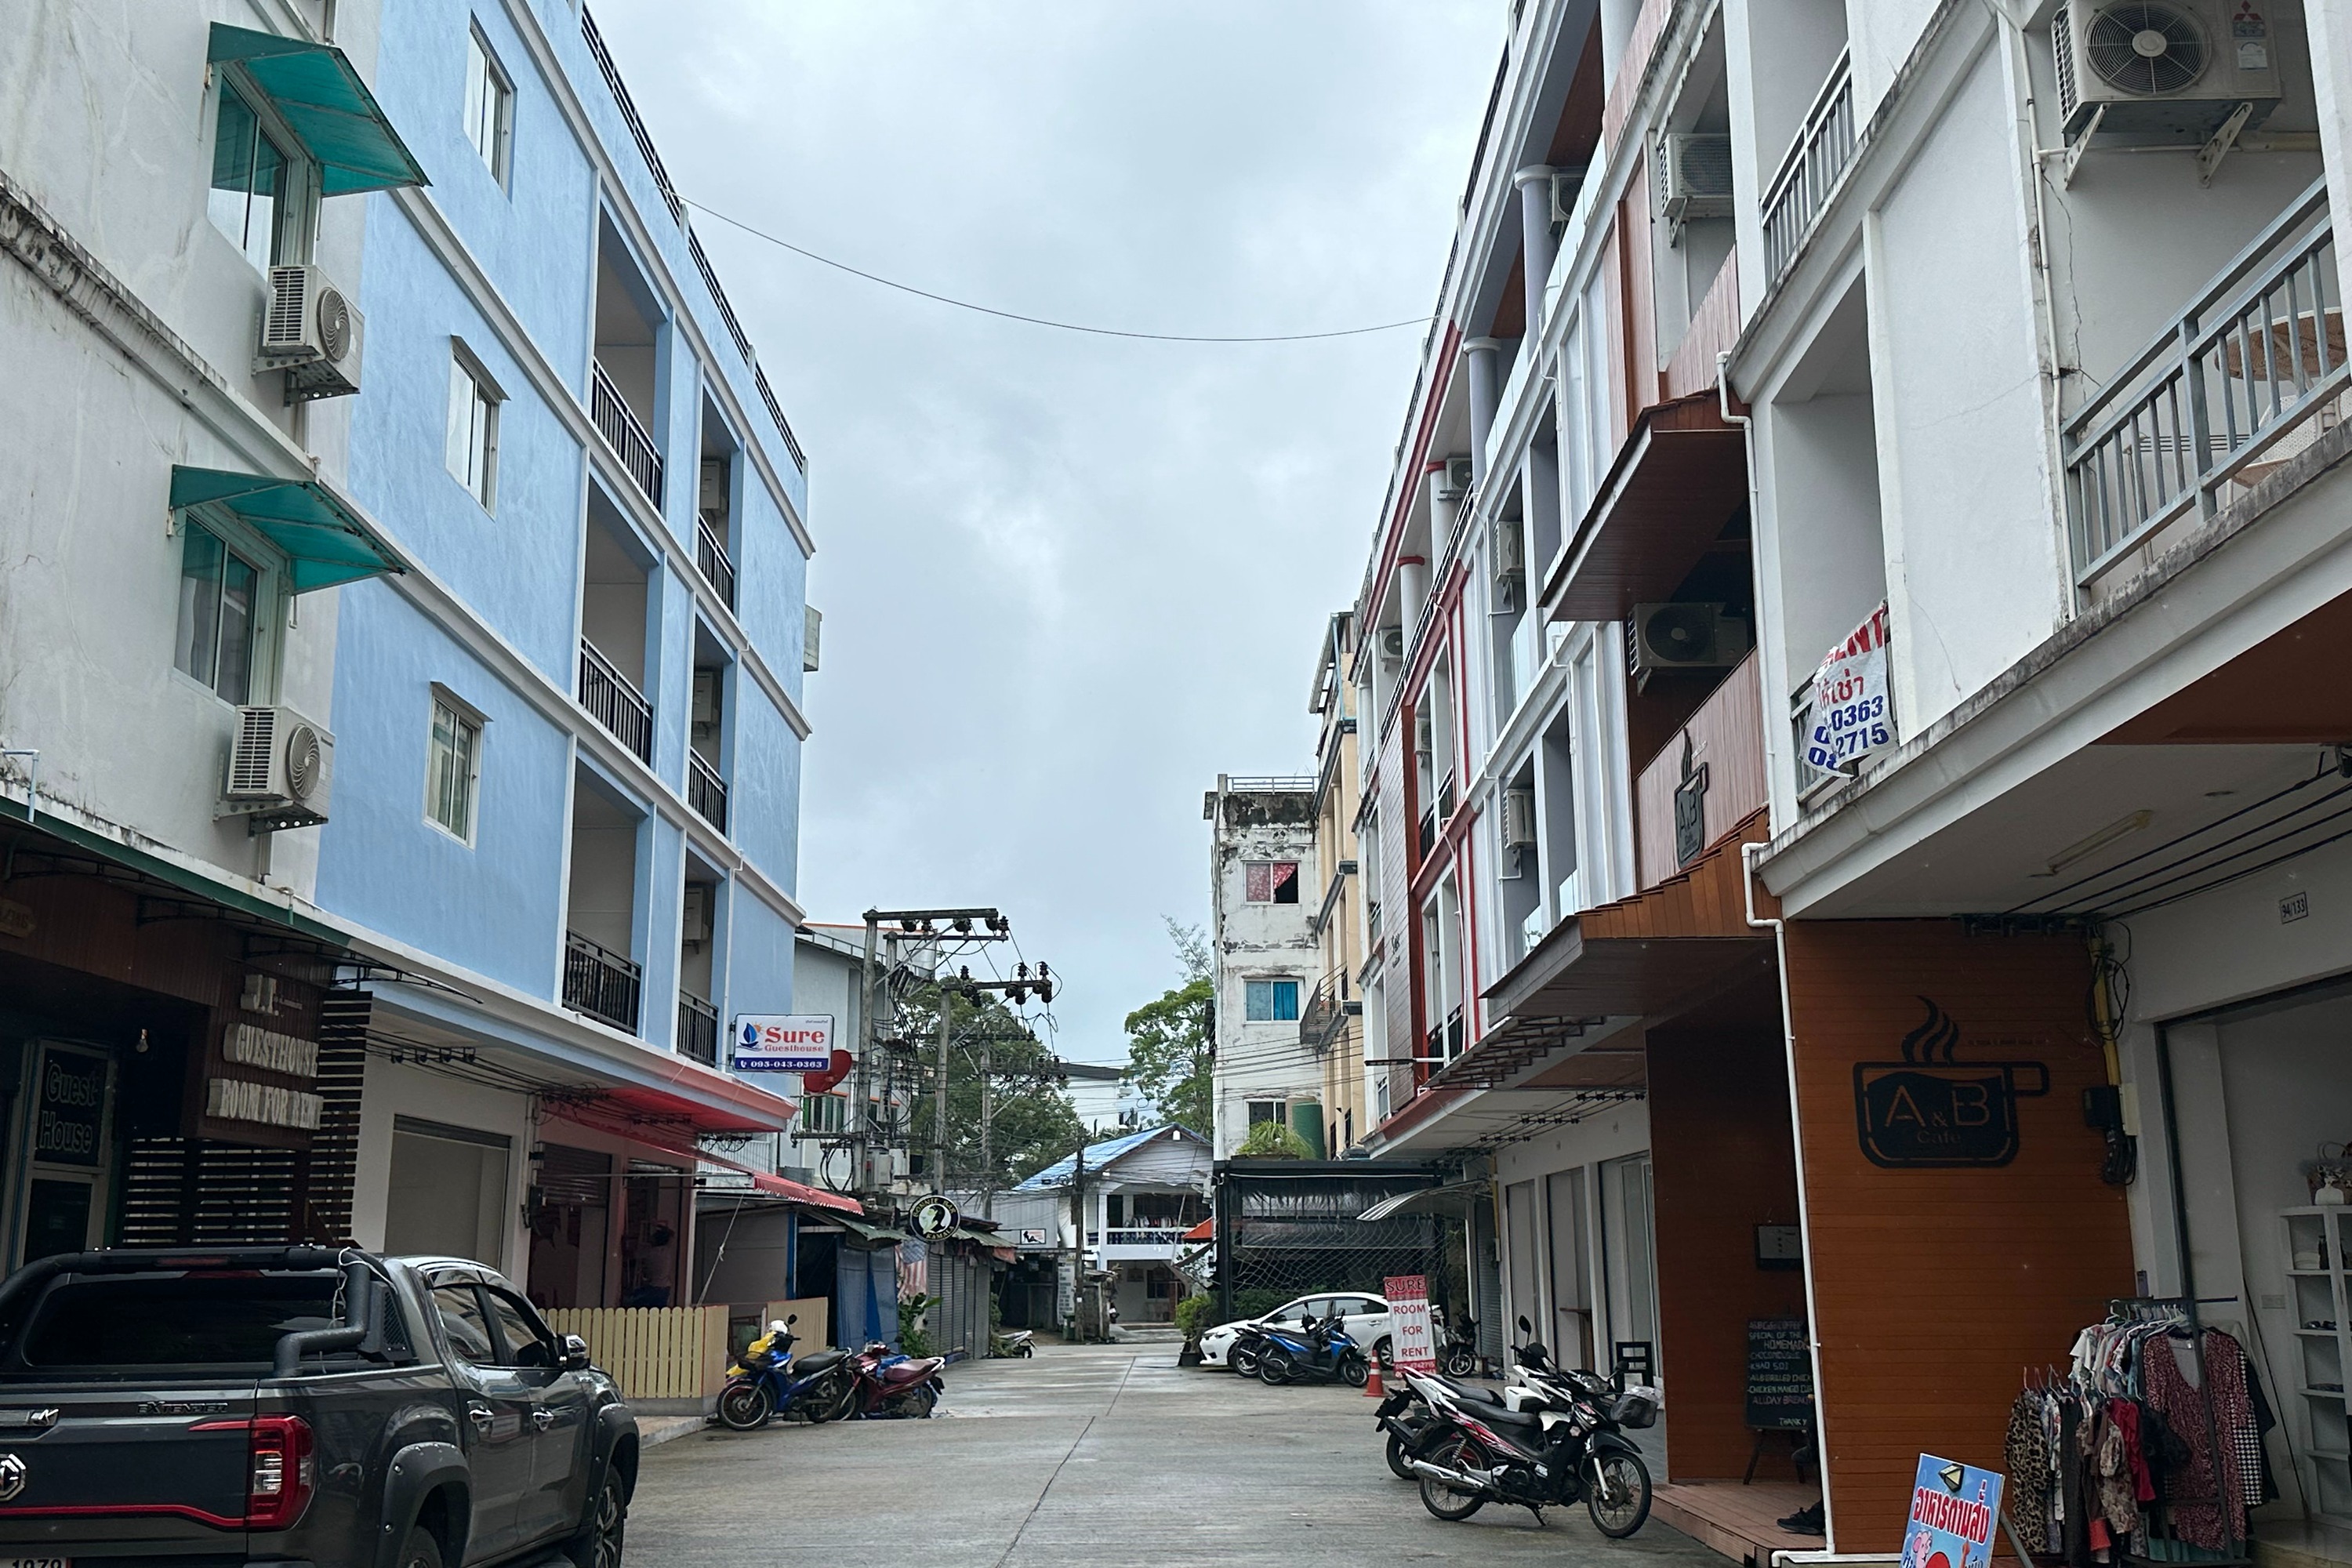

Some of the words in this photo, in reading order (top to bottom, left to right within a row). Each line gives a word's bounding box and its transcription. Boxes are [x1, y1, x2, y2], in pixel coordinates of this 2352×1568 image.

[764, 1026, 825, 1044] Sure
[228, 1022, 319, 1077] GUESTHOUSE
[47, 1063, 96, 1106] Guest
[213, 1078, 262, 1122] ROOM
[263, 1086, 289, 1124] FOR
[39, 1109, 93, 1153] House
[1386, 1279, 1425, 1292] SURE
[1394, 1305, 1425, 1314] ROOM
[1402, 1326, 1422, 1335] FOR
[1401, 1347, 1428, 1357] RENT
[138, 1401, 228, 1414] EXTENDER
[1913, 1480, 1991, 1545] อาหารตามสั่ง
